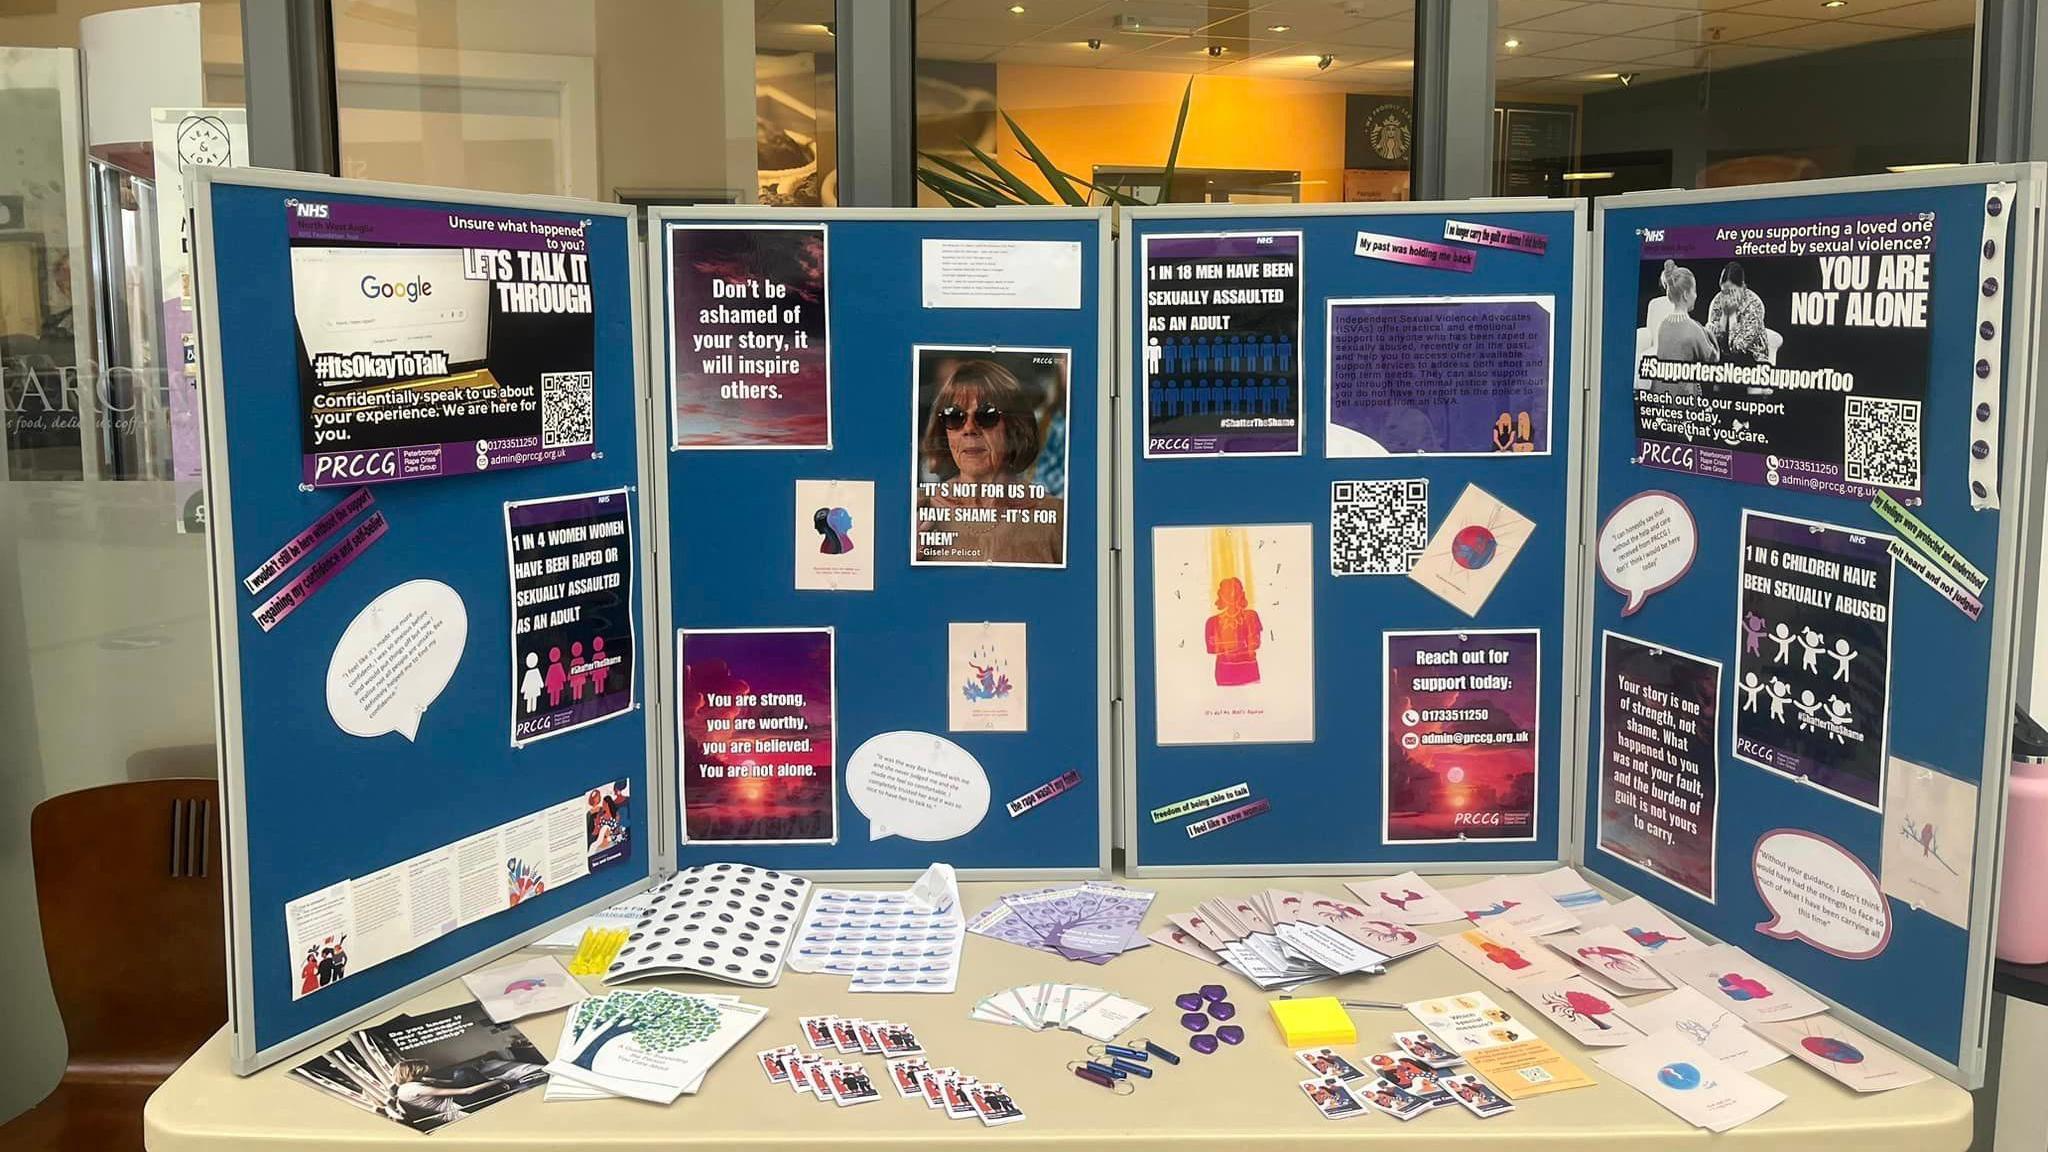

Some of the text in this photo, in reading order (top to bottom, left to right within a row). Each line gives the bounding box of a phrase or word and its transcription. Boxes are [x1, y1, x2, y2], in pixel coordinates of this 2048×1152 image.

[200, 142, 208, 152] &
[297, 203, 329, 217] NHS
[449, 216, 583, 237] Unsure what happened
[1645, 229, 1664, 242] NHS
[1716, 221, 1933, 244] Are you supporting a loved one
[547, 239, 585, 252] to you?
[1360, 238, 1472, 264] My past was holding me back
[1735, 236, 1932, 256] affected by sexual violence?
[464, 248, 587, 282] LETS TALK IT
[1149, 263, 1294, 280] 1 IN 18 MEN HAVE BEEN
[1819, 255, 1931, 290] YOU ARE
[361, 275, 432, 302] Google
[497, 282, 592, 313] THROUGH
[713, 279, 785, 298] Don't be
[1149, 289, 1284, 305] SEXUALLY ASSAULTED
[700, 305, 801, 324] ashamed of
[1791, 292, 1927, 328] NOT ALONE
[1149, 316, 1230, 331] AS AN ADULT
[693, 331, 808, 352] your story, it
[315, 354, 448, 378] #ItsOkayToTalk
[703, 355, 800, 377] will inspire
[1641, 359, 1853, 392] #SupportersNeedSupportToo
[720, 380, 782, 399] others.
[1221, 418, 1295, 428] #ShatterTheShame
[488, 437, 537, 450] 01733511250
[1150, 438, 1190, 450] PRCCG
[316, 452, 396, 479] PRCCG
[491, 449, 566, 464] admin@prccg.org.uk
[1640, 441, 1693, 471] PRCCG
[1779, 459, 1838, 475] 01733511250
[954, 484, 976, 497] NOT
[982, 484, 1004, 498] FOR
[1008, 485, 1024, 498] US
[1029, 485, 1045, 498] TO
[1782, 474, 1878, 497] admin@prccg.org.uk
[919, 508, 950, 521] HAVE
[955, 509, 997, 522] SHAME
[1034, 510, 1056, 524] FOR
[513, 521, 624, 551] 1 IN 4 WOMEN WOMEN
[919, 532, 958, 545] THEM"
[1849, 535, 1866, 544] NHS
[516, 548, 618, 579] HAVE BEEN RAPED OR
[1746, 545, 1876, 589] 1 IN 6 CHILDREN HAVE
[258, 592, 295, 626] regaining
[291, 584, 305, 600] my
[303, 553, 340, 588] confidence
[517, 573, 620, 607] SEXUALLY ASSAULTED
[1890, 543, 1980, 615] felt heard and not judged
[1744, 573, 1886, 622] BEEN SEXUALLY ABUSED
[517, 606, 581, 634] AS AN ADULT
[1416, 650, 1509, 665] Reach out for
[1413, 675, 1512, 691] support today:
[1619, 674, 1700, 715] Your story is one
[517, 716, 551, 736] PRCCG
[1422, 709, 1488, 721] 01733511250
[1620, 697, 1696, 734] of strength, not
[1422, 731, 1528, 746] admin@prccg.org.uk
[1626, 718, 1688, 751] shame. What
[1798, 712, 1864, 742] #ShatterTheShame
[1618, 731, 1698, 774] happened to you
[1737, 738, 1773, 762] PRCCG
[1613, 751, 1703, 799] was not your fault,
[1614, 771, 1701, 815] and the burden of
[1454, 813, 1499, 825] PRCCG
[1615, 790, 1697, 834] guilt is not yours
[1634, 814, 1675, 845] to carry.
